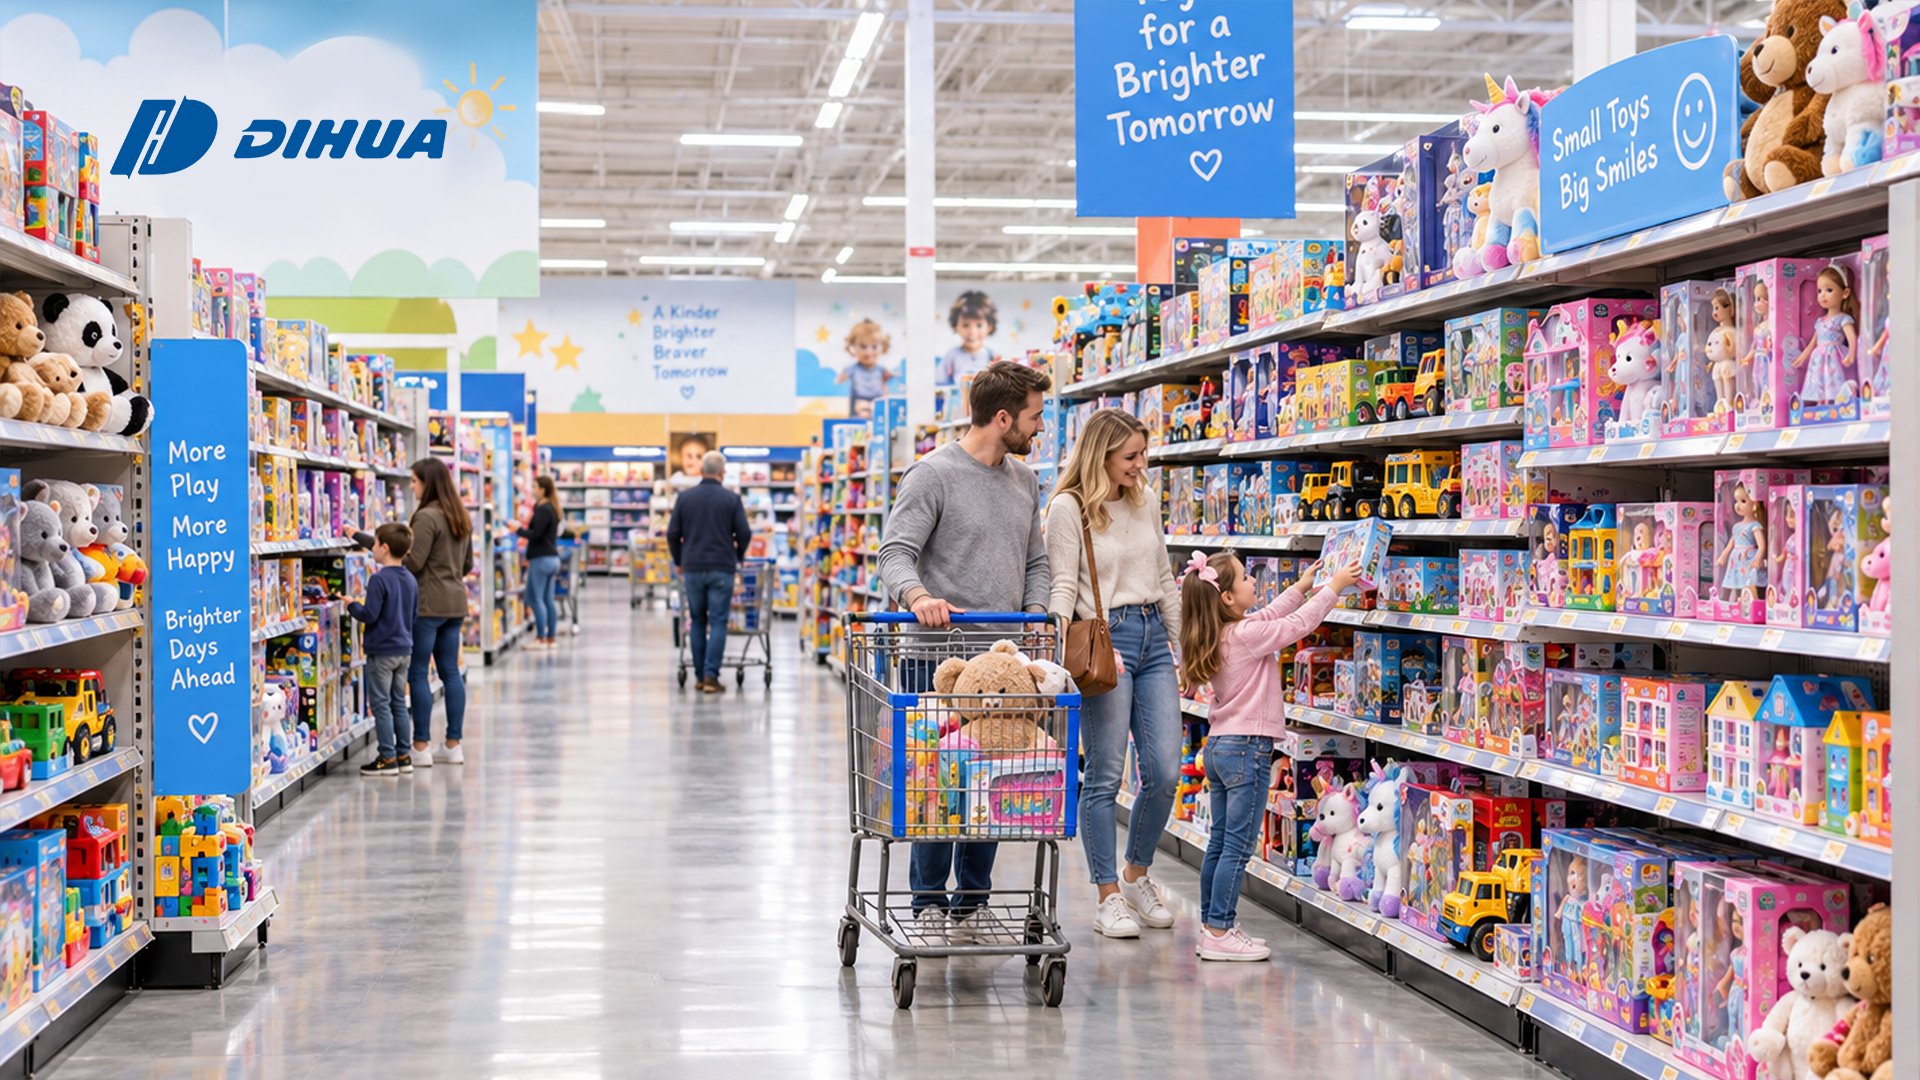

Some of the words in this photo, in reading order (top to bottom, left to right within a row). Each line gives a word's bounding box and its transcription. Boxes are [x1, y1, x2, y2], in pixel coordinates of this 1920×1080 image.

[1139, 13, 1196, 50] for
[1210, 15, 1231, 38] a
[1114, 51, 1266, 102] Brighter
[1106, 98, 1274, 146] Tomorrow
[1552, 106, 1602, 163] Small
[1606, 93, 1650, 138] Toys
[1559, 172, 1591, 213] Big
[1596, 141, 1659, 192] Smiles
[652, 304, 665, 319] A
[670, 304, 720, 319] Kinder
[652, 324, 716, 344] Brighter
[653, 344, 707, 360] Braver
[652, 364, 728, 380] Tomorrow
[169, 440, 226, 464] More
[171, 473, 219, 502] Play
[172, 514, 227, 538] More
[167, 547, 235, 575] Happy
[165, 607, 242, 634] Brighter
[170, 639, 218, 664] Days
[171, 662, 236, 690] Ahead
